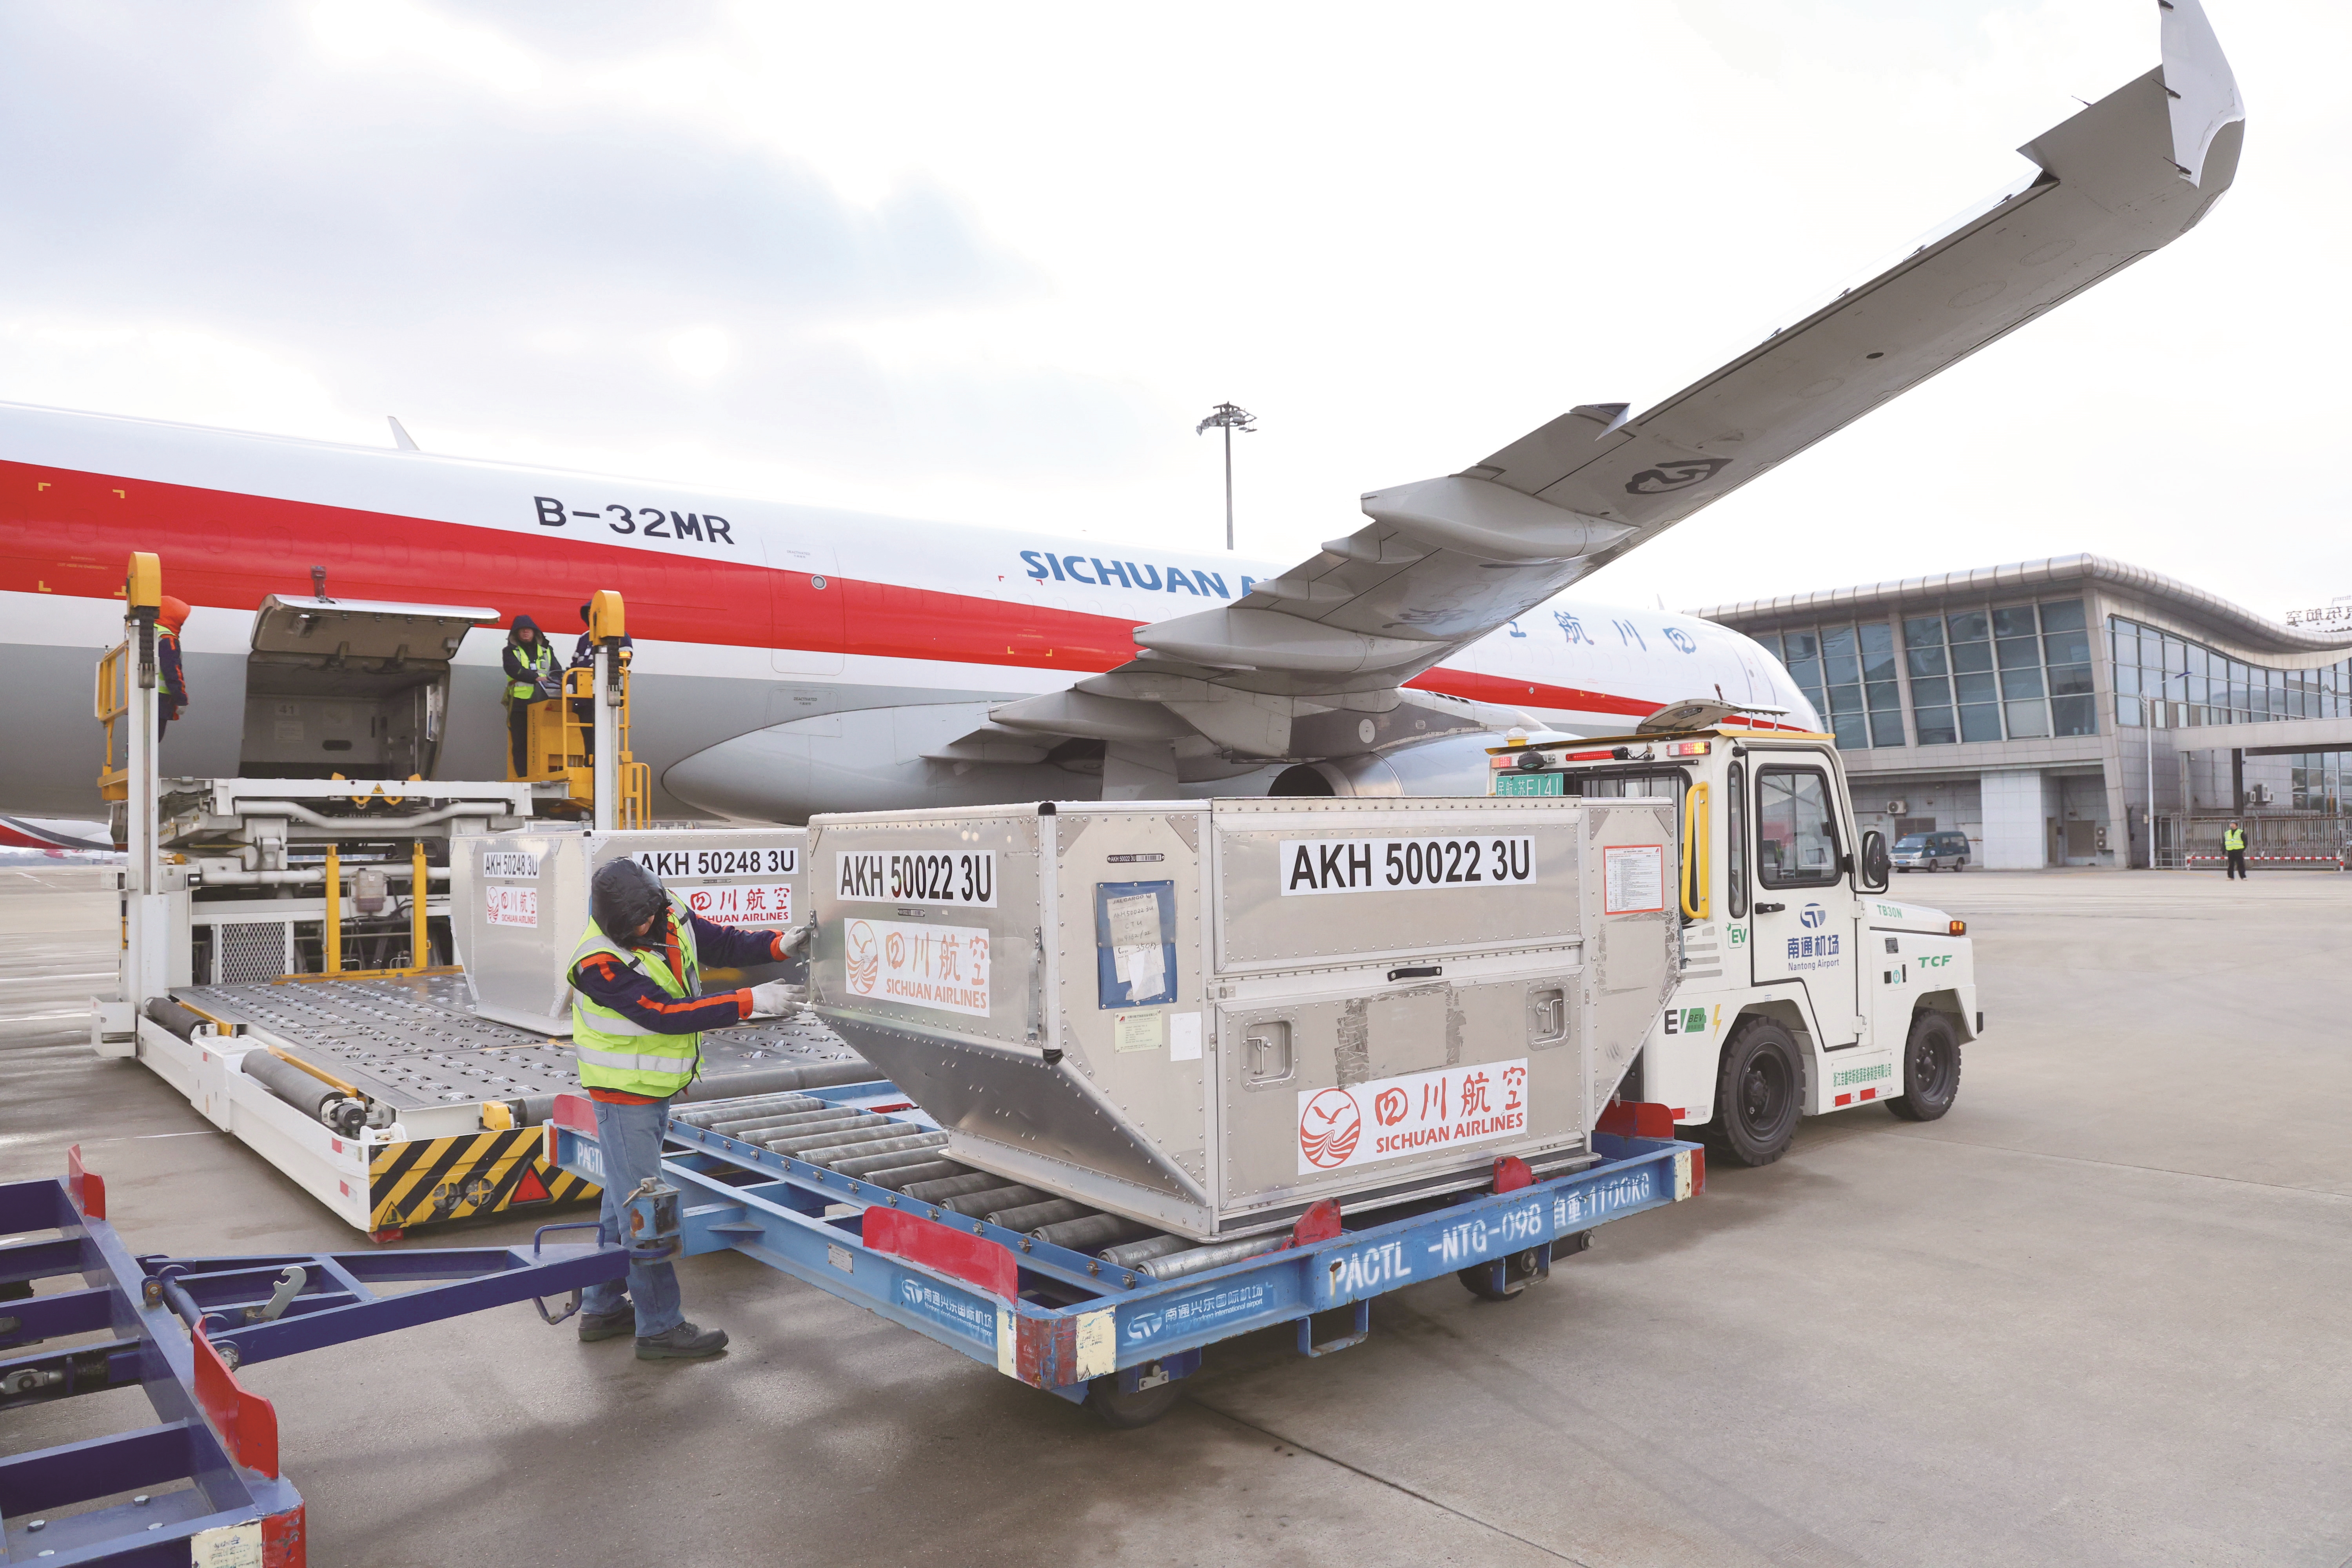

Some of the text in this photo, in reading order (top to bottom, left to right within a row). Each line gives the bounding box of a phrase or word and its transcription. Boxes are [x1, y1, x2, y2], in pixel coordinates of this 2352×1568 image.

[534, 496, 735, 544] B-32MR
[1020, 550, 1231, 599] SICHUAN
[485, 855, 537, 876] AKH 50248 3U
[642, 850, 793, 875] AKH 50248 3U
[1290, 840, 1530, 890] AKH 50022 3U
[841, 855, 991, 902] AKH 50022 3U
[501, 891, 536, 914] 四川航空
[690, 887, 790, 911] 四川航空
[1877, 904, 1902, 918] TB30N
[501, 914, 536, 924] SICHUAN AIRLINES
[704, 912, 788, 923] HUAN AIRLINES
[1732, 928, 1747, 943] EV
[1788, 935, 1838, 959] 南通机场
[886, 932, 988, 985] 四川航空
[1788, 959, 1839, 971] Nantong Airport
[1918, 955, 1952, 968] TCF
[887, 978, 986, 1009] SICHUAN AIRLINES
[1688, 1014, 1704, 1022] BEV
[1375, 1067, 1526, 1126] 四川航空
[1376, 1112, 1523, 1153] SICHUAN AIRLINES
[1330, 1241, 1411, 1296] PACTL
[924, 1287, 993, 1329] 南通兴东国际机场
[1165, 1284, 1263, 1323] 南通兴东国际机场
[1214, 1304, 1246, 1318] international
